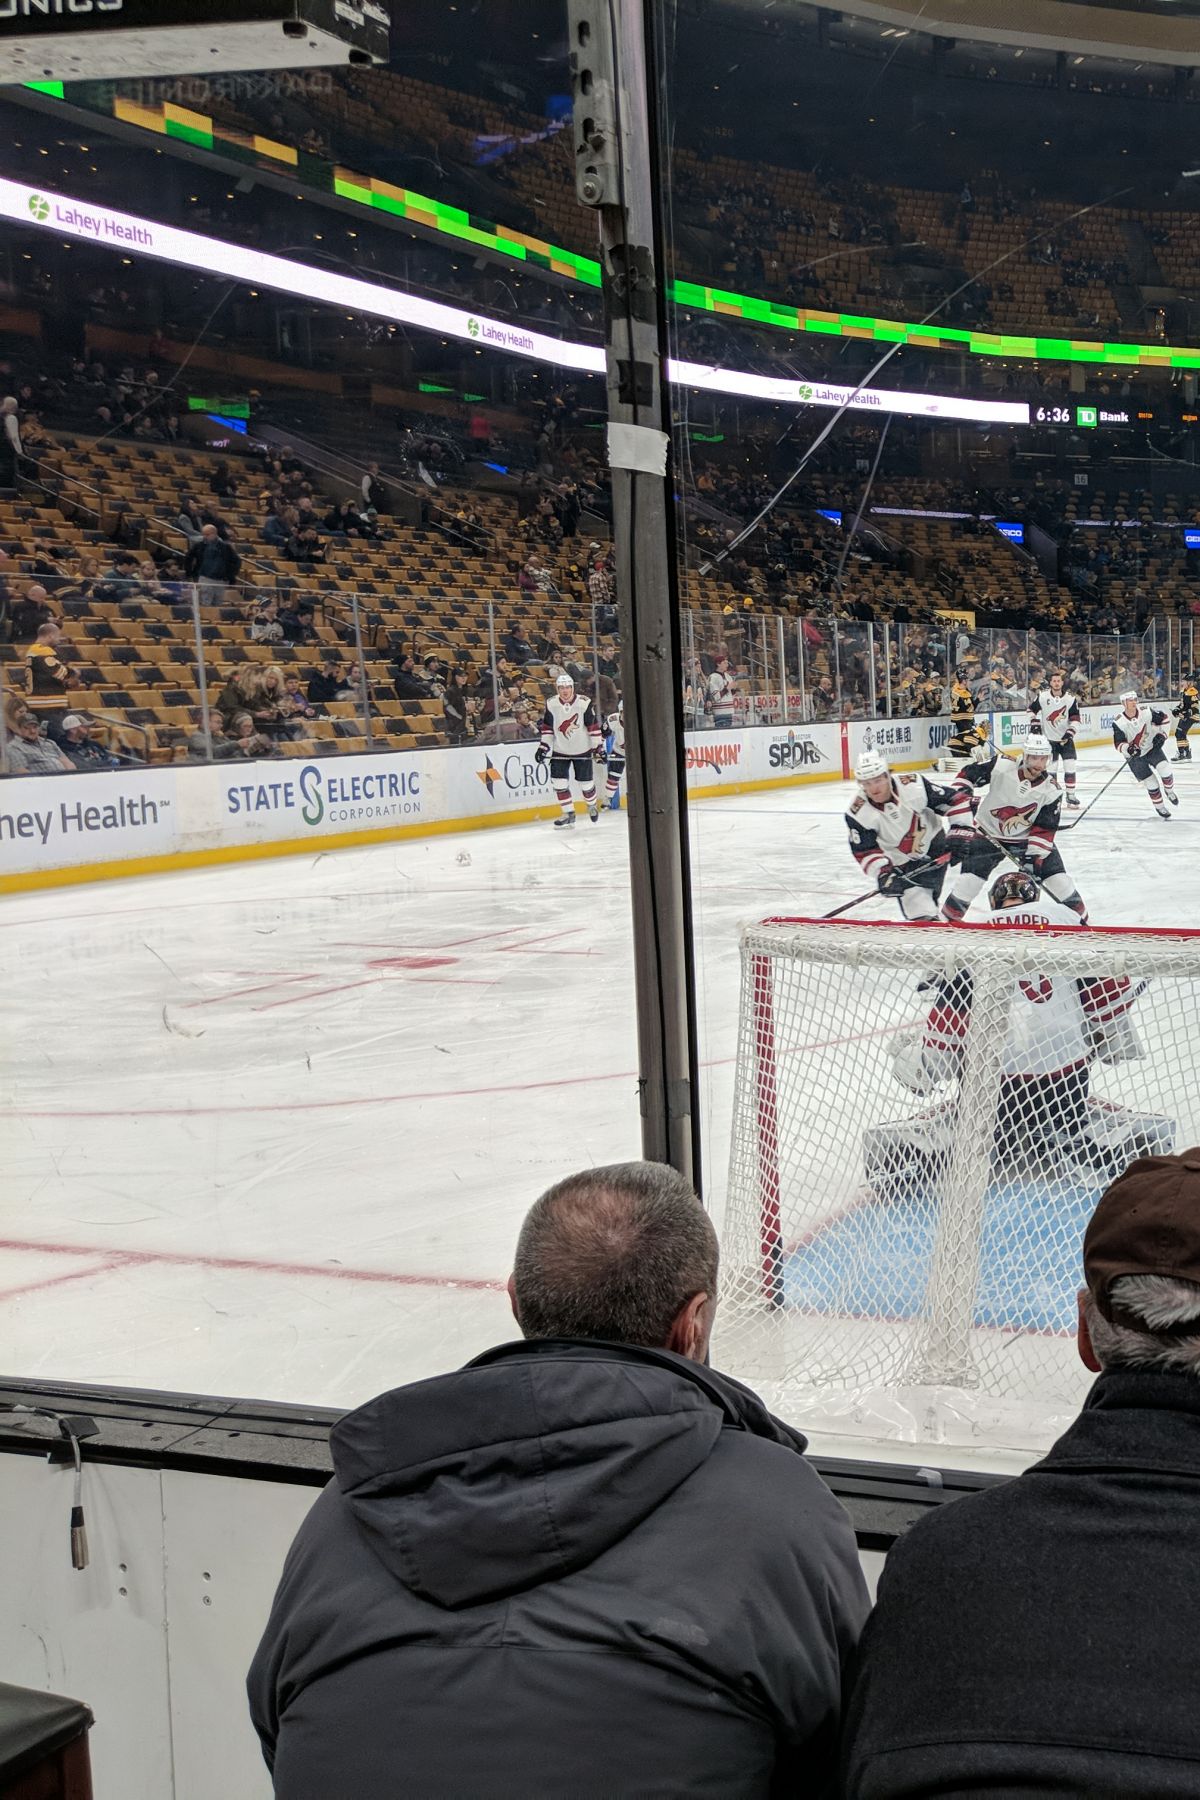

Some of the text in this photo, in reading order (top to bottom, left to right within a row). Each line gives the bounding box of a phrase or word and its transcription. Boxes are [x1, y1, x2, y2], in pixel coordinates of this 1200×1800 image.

[56, 204, 153, 246] Lahey Health
[482, 324, 534, 350] Lahey Health
[816, 389, 880, 405] Lahey Health
[1036, 407, 1070, 422] 6:36
[1079, 410, 1095, 422] TD
[1100, 411, 1129, 423] Bank
[685, 743, 741, 769] DUNKIN'
[504, 755, 549, 789] CRO
[227, 782, 295, 813] STATE
[327, 771, 420, 803] ELECTRIC
[508, 787, 549, 798] INSURA
[60, 794, 158, 834] Health
[329, 802, 421, 822] CORPORATION
